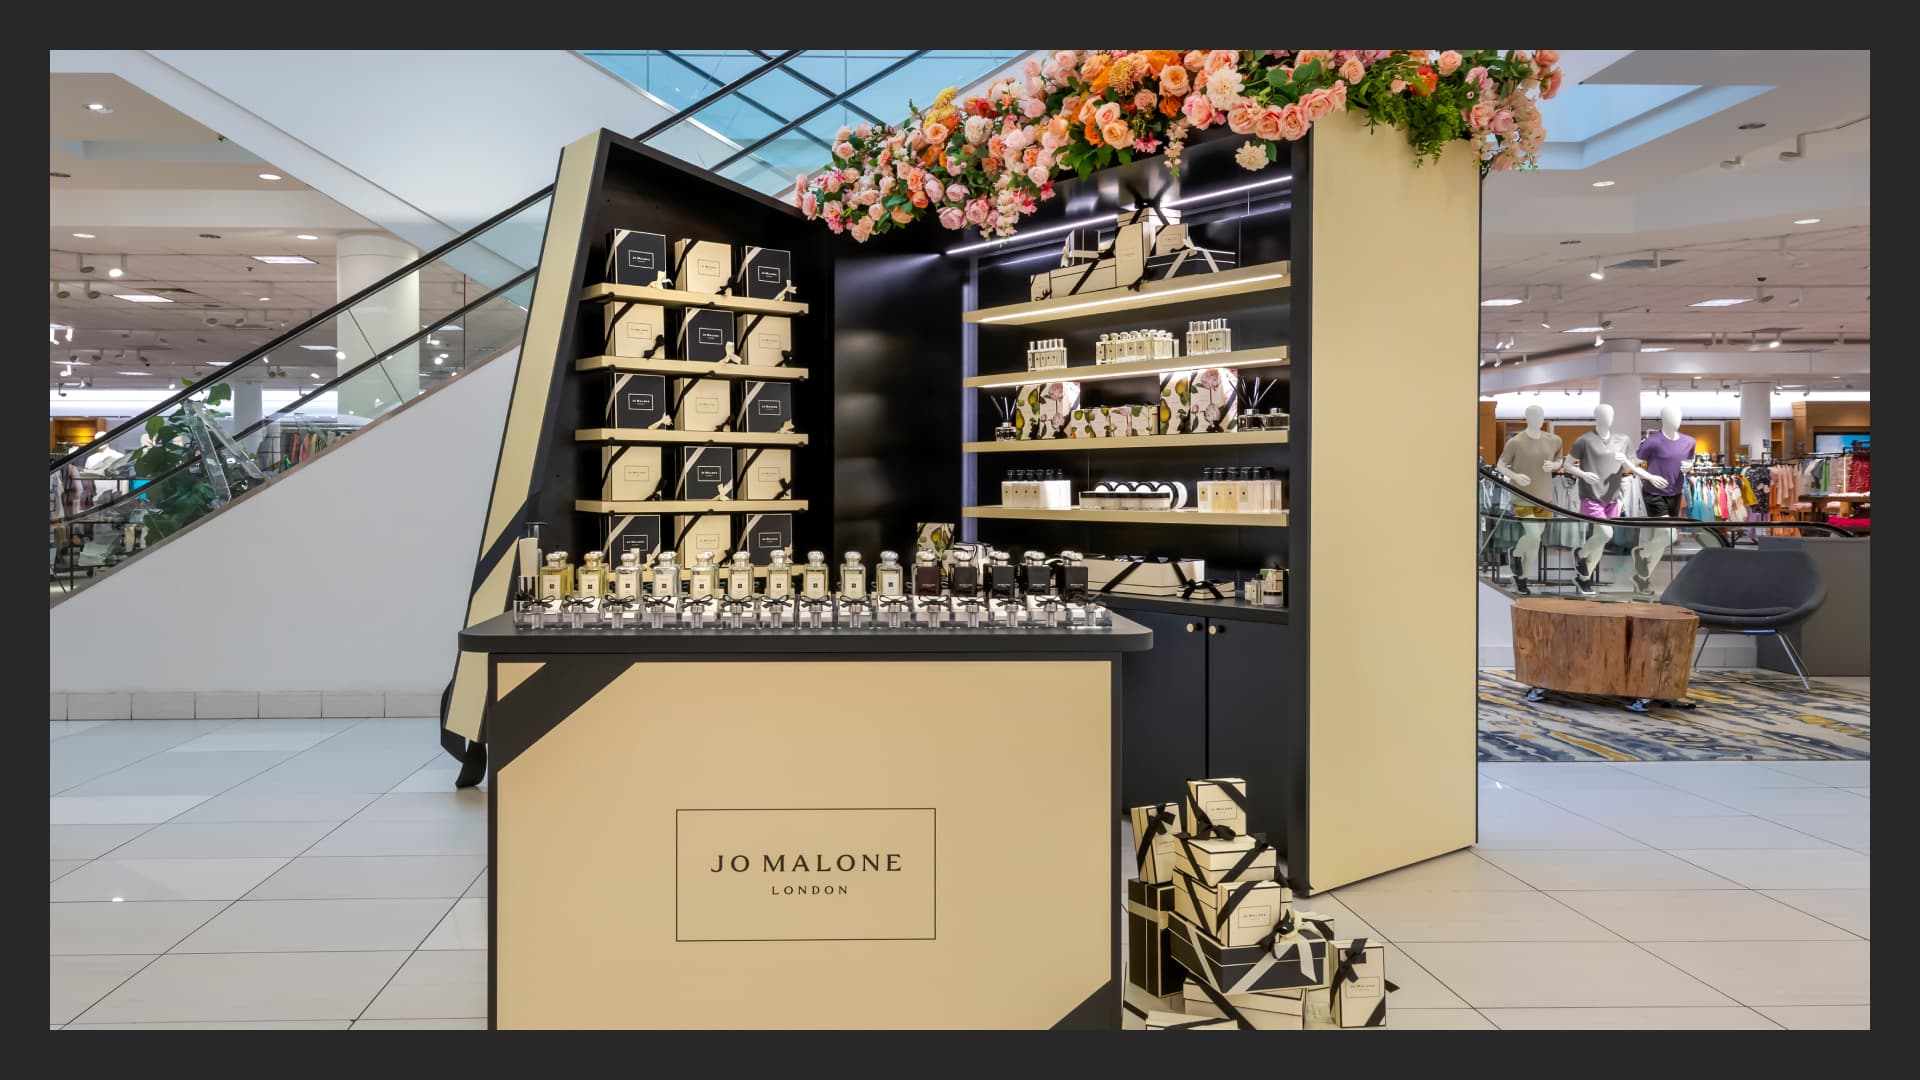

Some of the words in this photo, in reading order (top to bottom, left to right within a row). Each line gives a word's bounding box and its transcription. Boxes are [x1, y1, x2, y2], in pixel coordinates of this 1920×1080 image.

[710, 854, 750, 873] JO
[763, 853, 902, 873] MALONE
[771, 885, 848, 896] LONDON
